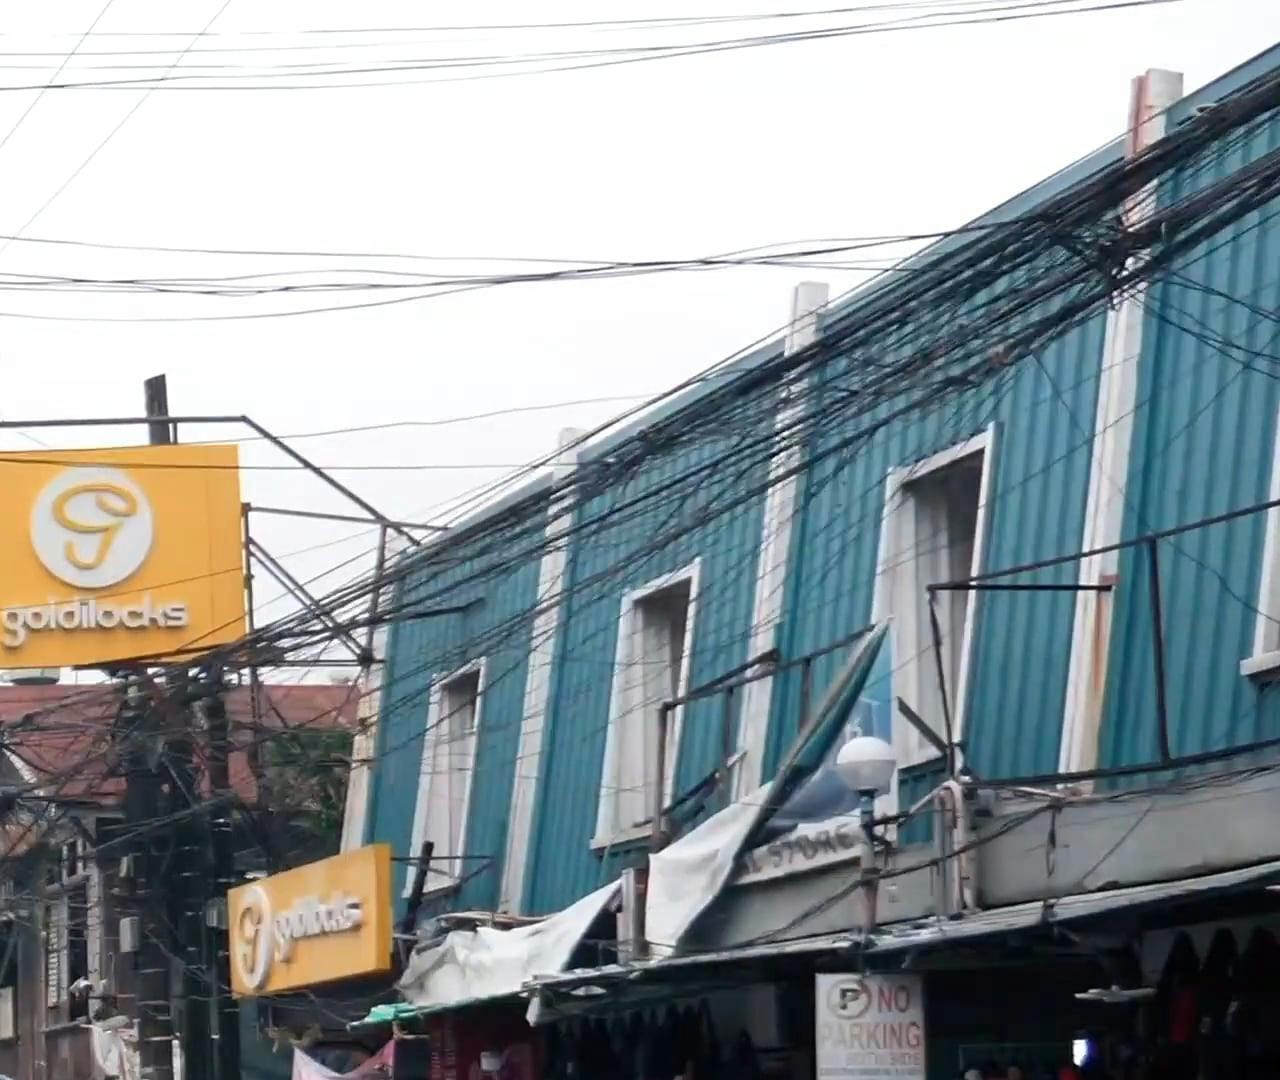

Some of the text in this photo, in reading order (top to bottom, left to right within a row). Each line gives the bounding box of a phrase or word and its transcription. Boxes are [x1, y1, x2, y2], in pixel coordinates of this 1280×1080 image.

[0, 592, 188, 648] goldilocks
[877, 984, 911, 1014] NO
[819, 1022, 921, 1050] PARKING
